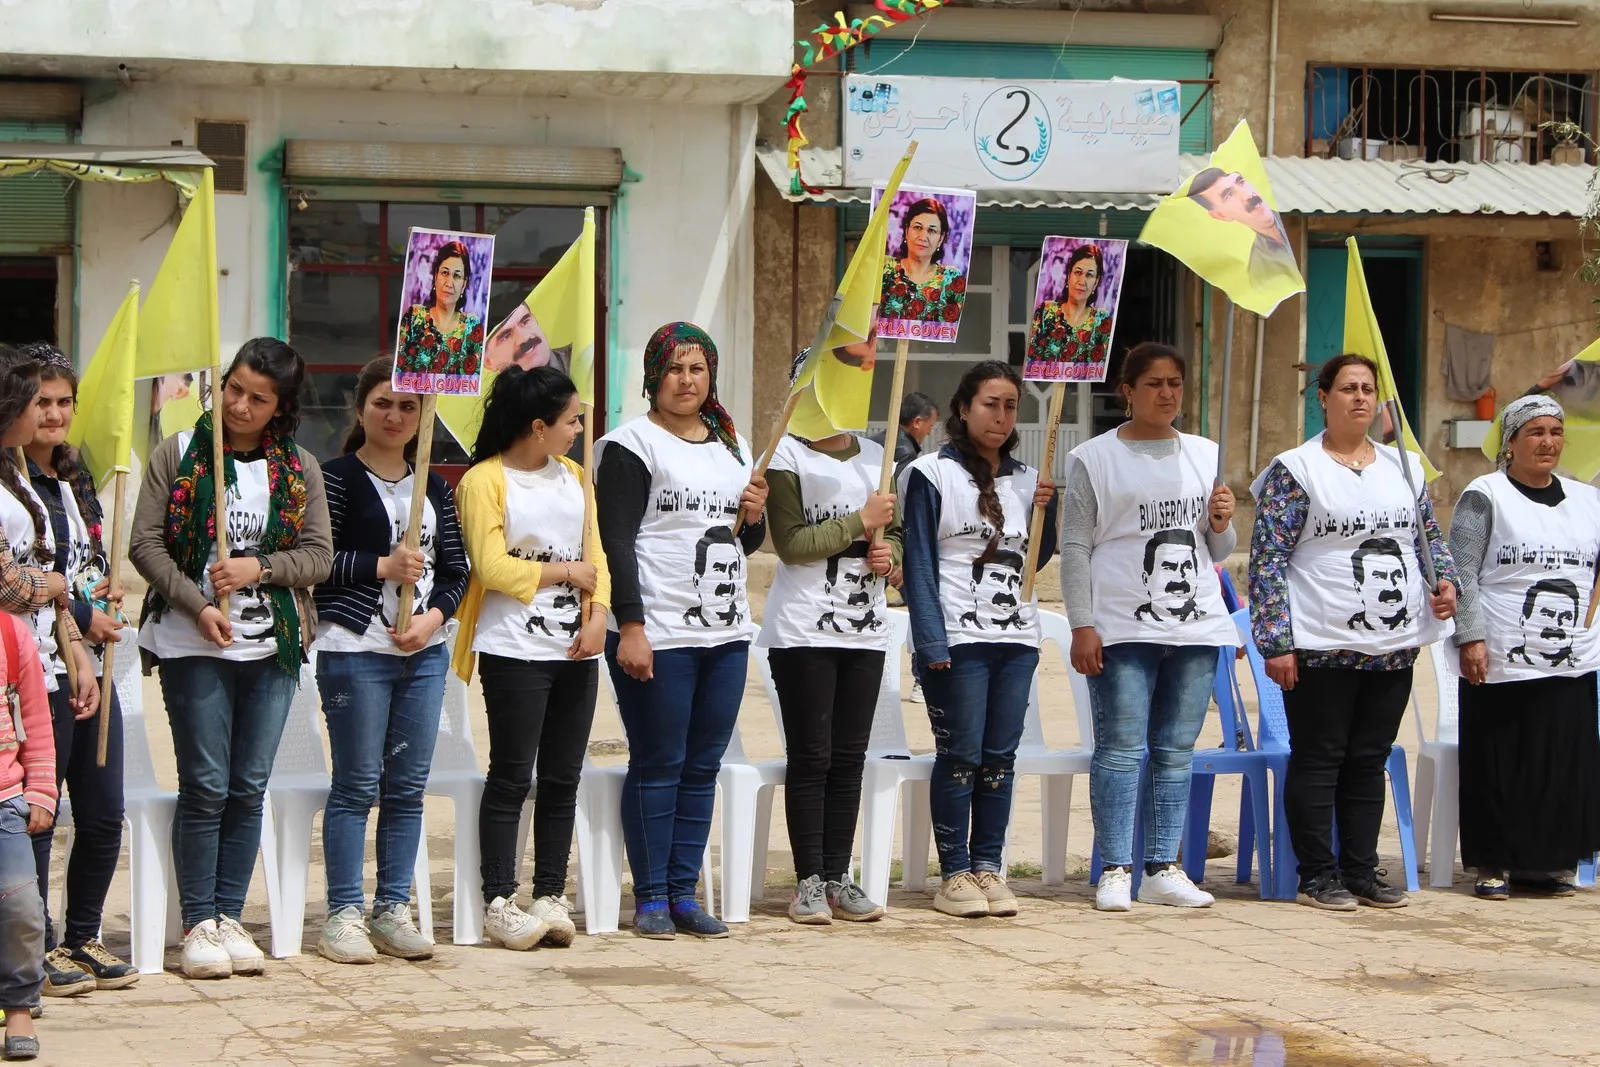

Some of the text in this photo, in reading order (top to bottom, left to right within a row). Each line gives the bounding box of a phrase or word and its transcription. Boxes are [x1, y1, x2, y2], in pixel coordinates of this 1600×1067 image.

[1055, 96, 1174, 146] صيدلية
[878, 321, 906, 335] YLA
[395, 375, 478, 392] LEYLA GÜVEN
[1023, 364, 1104, 378] LEYLA GÜVEN
[1139, 500, 1157, 531] BIJÎ
[1159, 499, 1189, 528] SEROK
[1314, 512, 1338, 537] عفرين
[1340, 510, 1366, 537] تحرير
